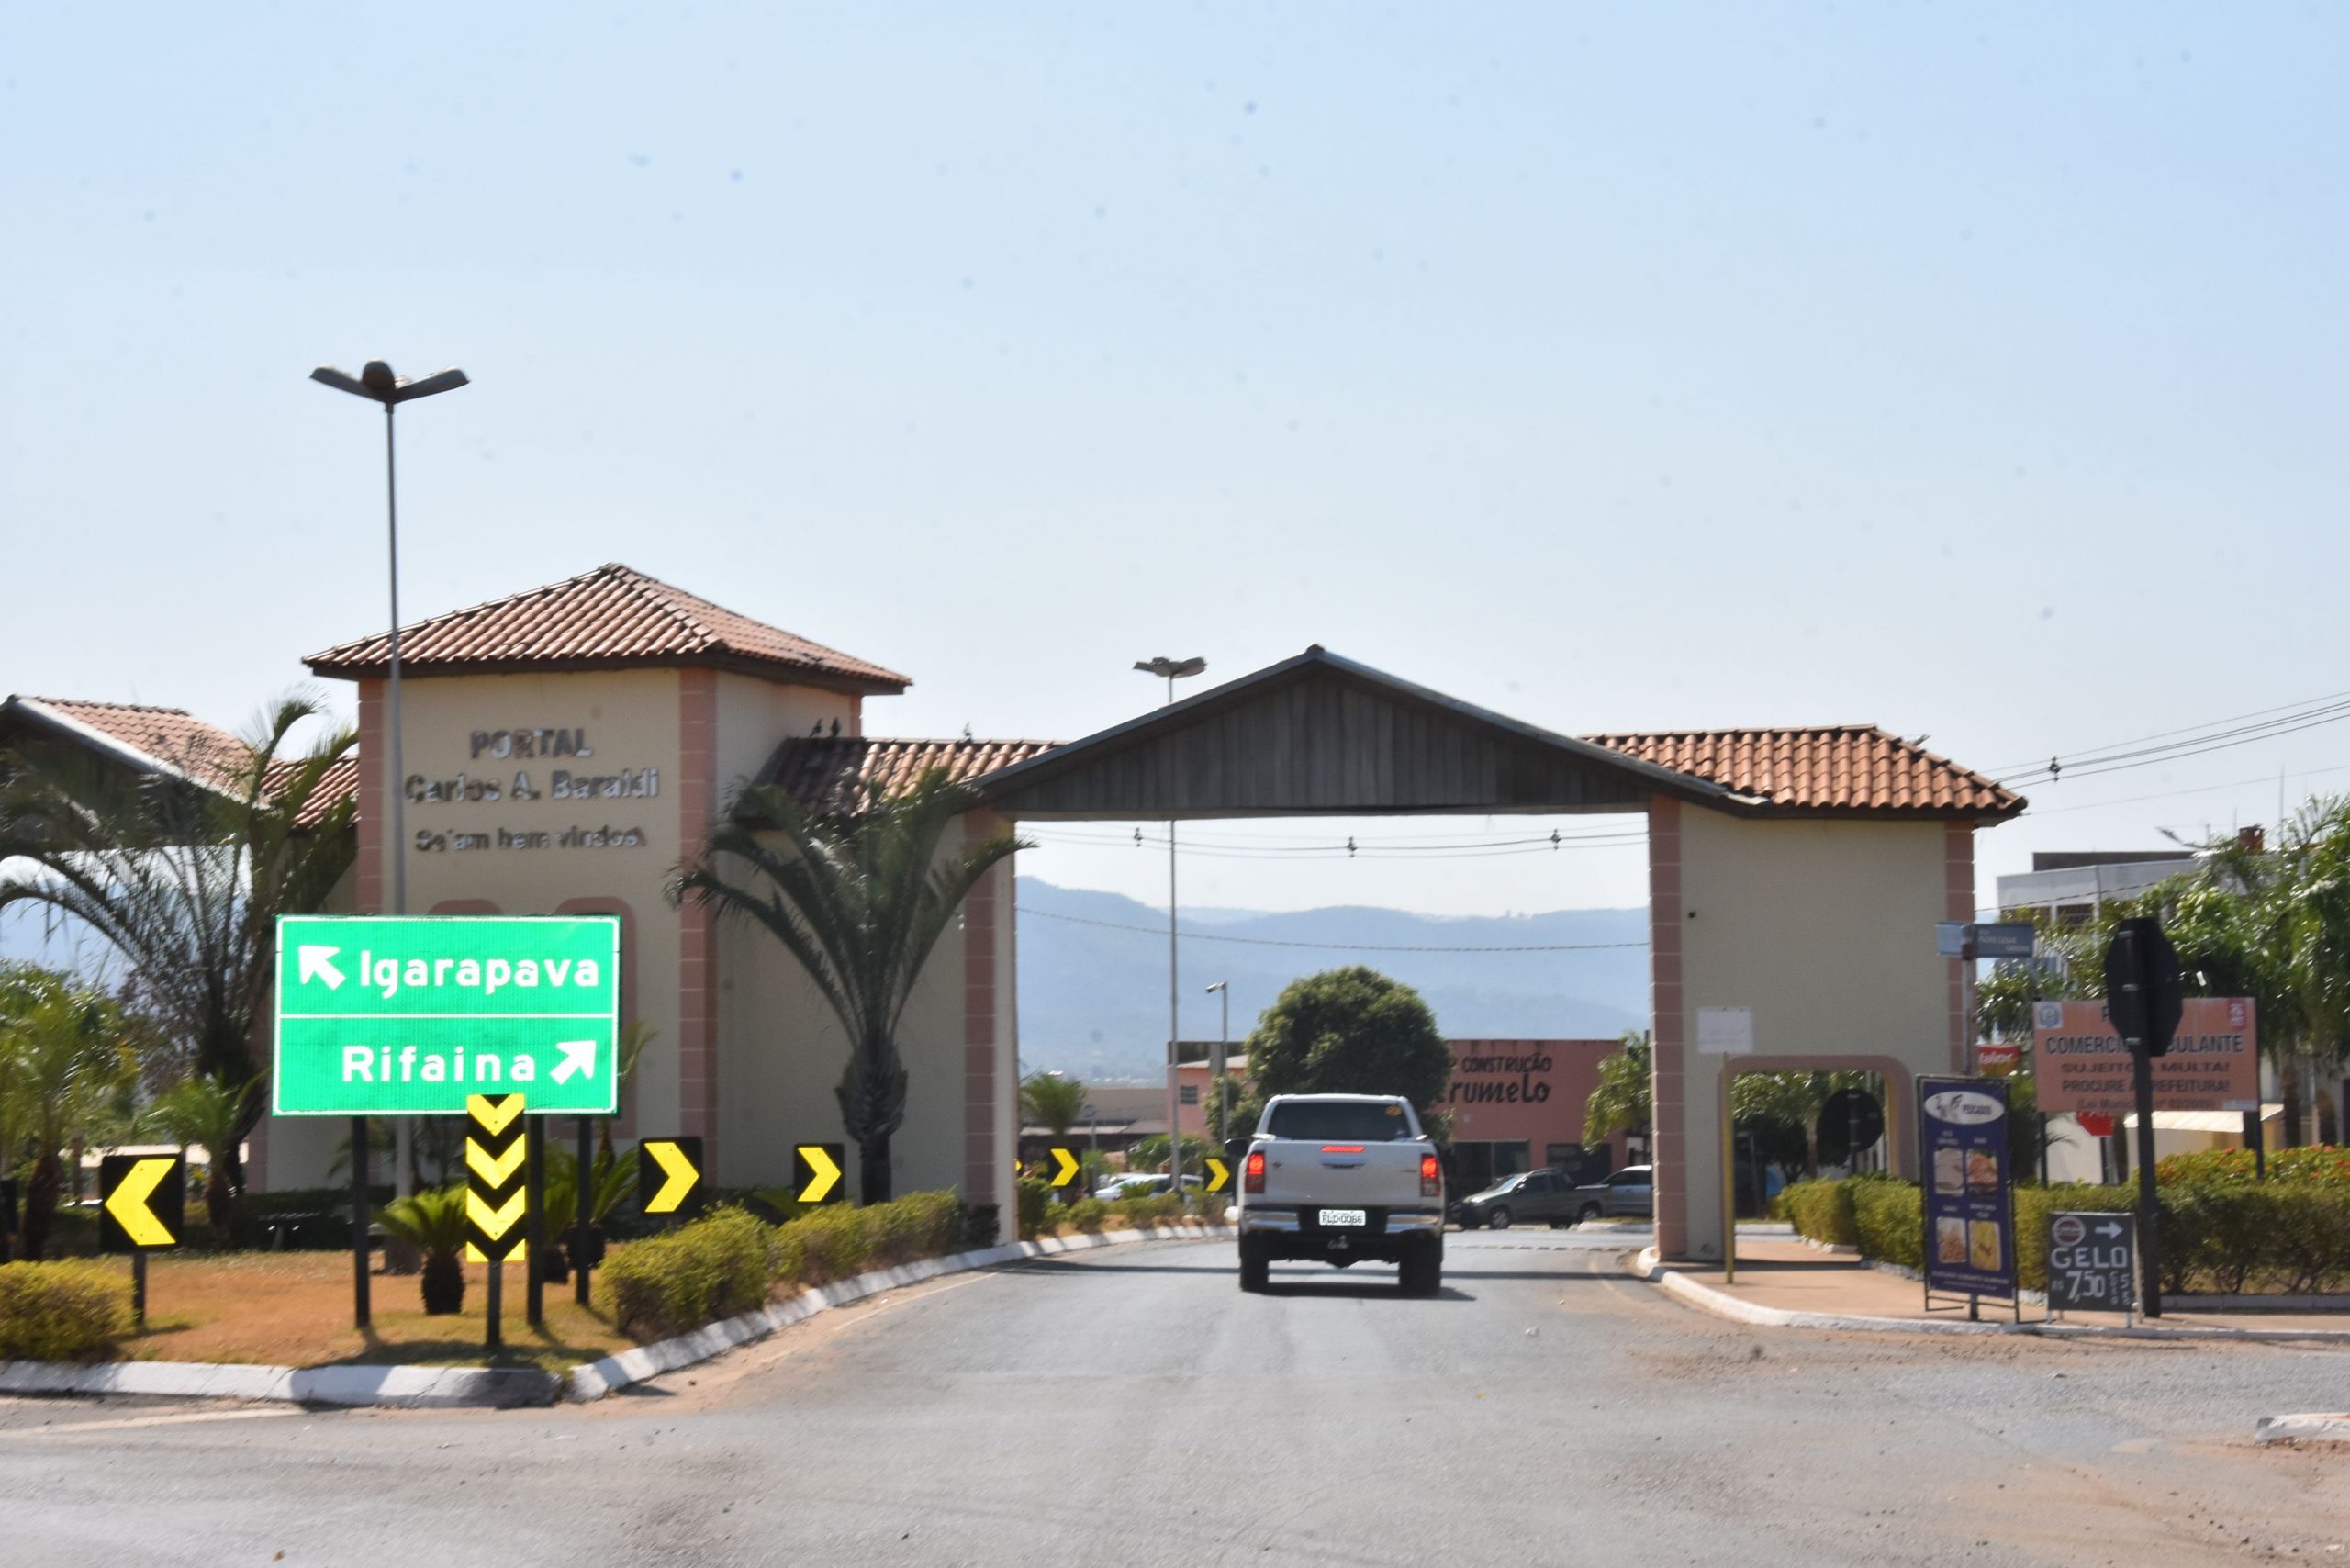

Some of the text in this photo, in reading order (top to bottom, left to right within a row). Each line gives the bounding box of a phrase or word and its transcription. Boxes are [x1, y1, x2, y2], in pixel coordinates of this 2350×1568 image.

[469, 729, 594, 759] PORTAL
[405, 772, 501, 803] Carlos
[416, 828, 489, 852] Seam
[360, 949, 599, 1000] Igarapava
[342, 1045, 535, 1082] Rifaina
[1461, 1052, 1552, 1074] CONSTRUÇÃO
[2062, 1079, 2126, 1092] PROCURE
[2151, 1079, 2231, 1092] REFEITURA!
[2051, 1247, 2128, 1269] GELO
[2065, 1271, 2106, 1304] 7,50
